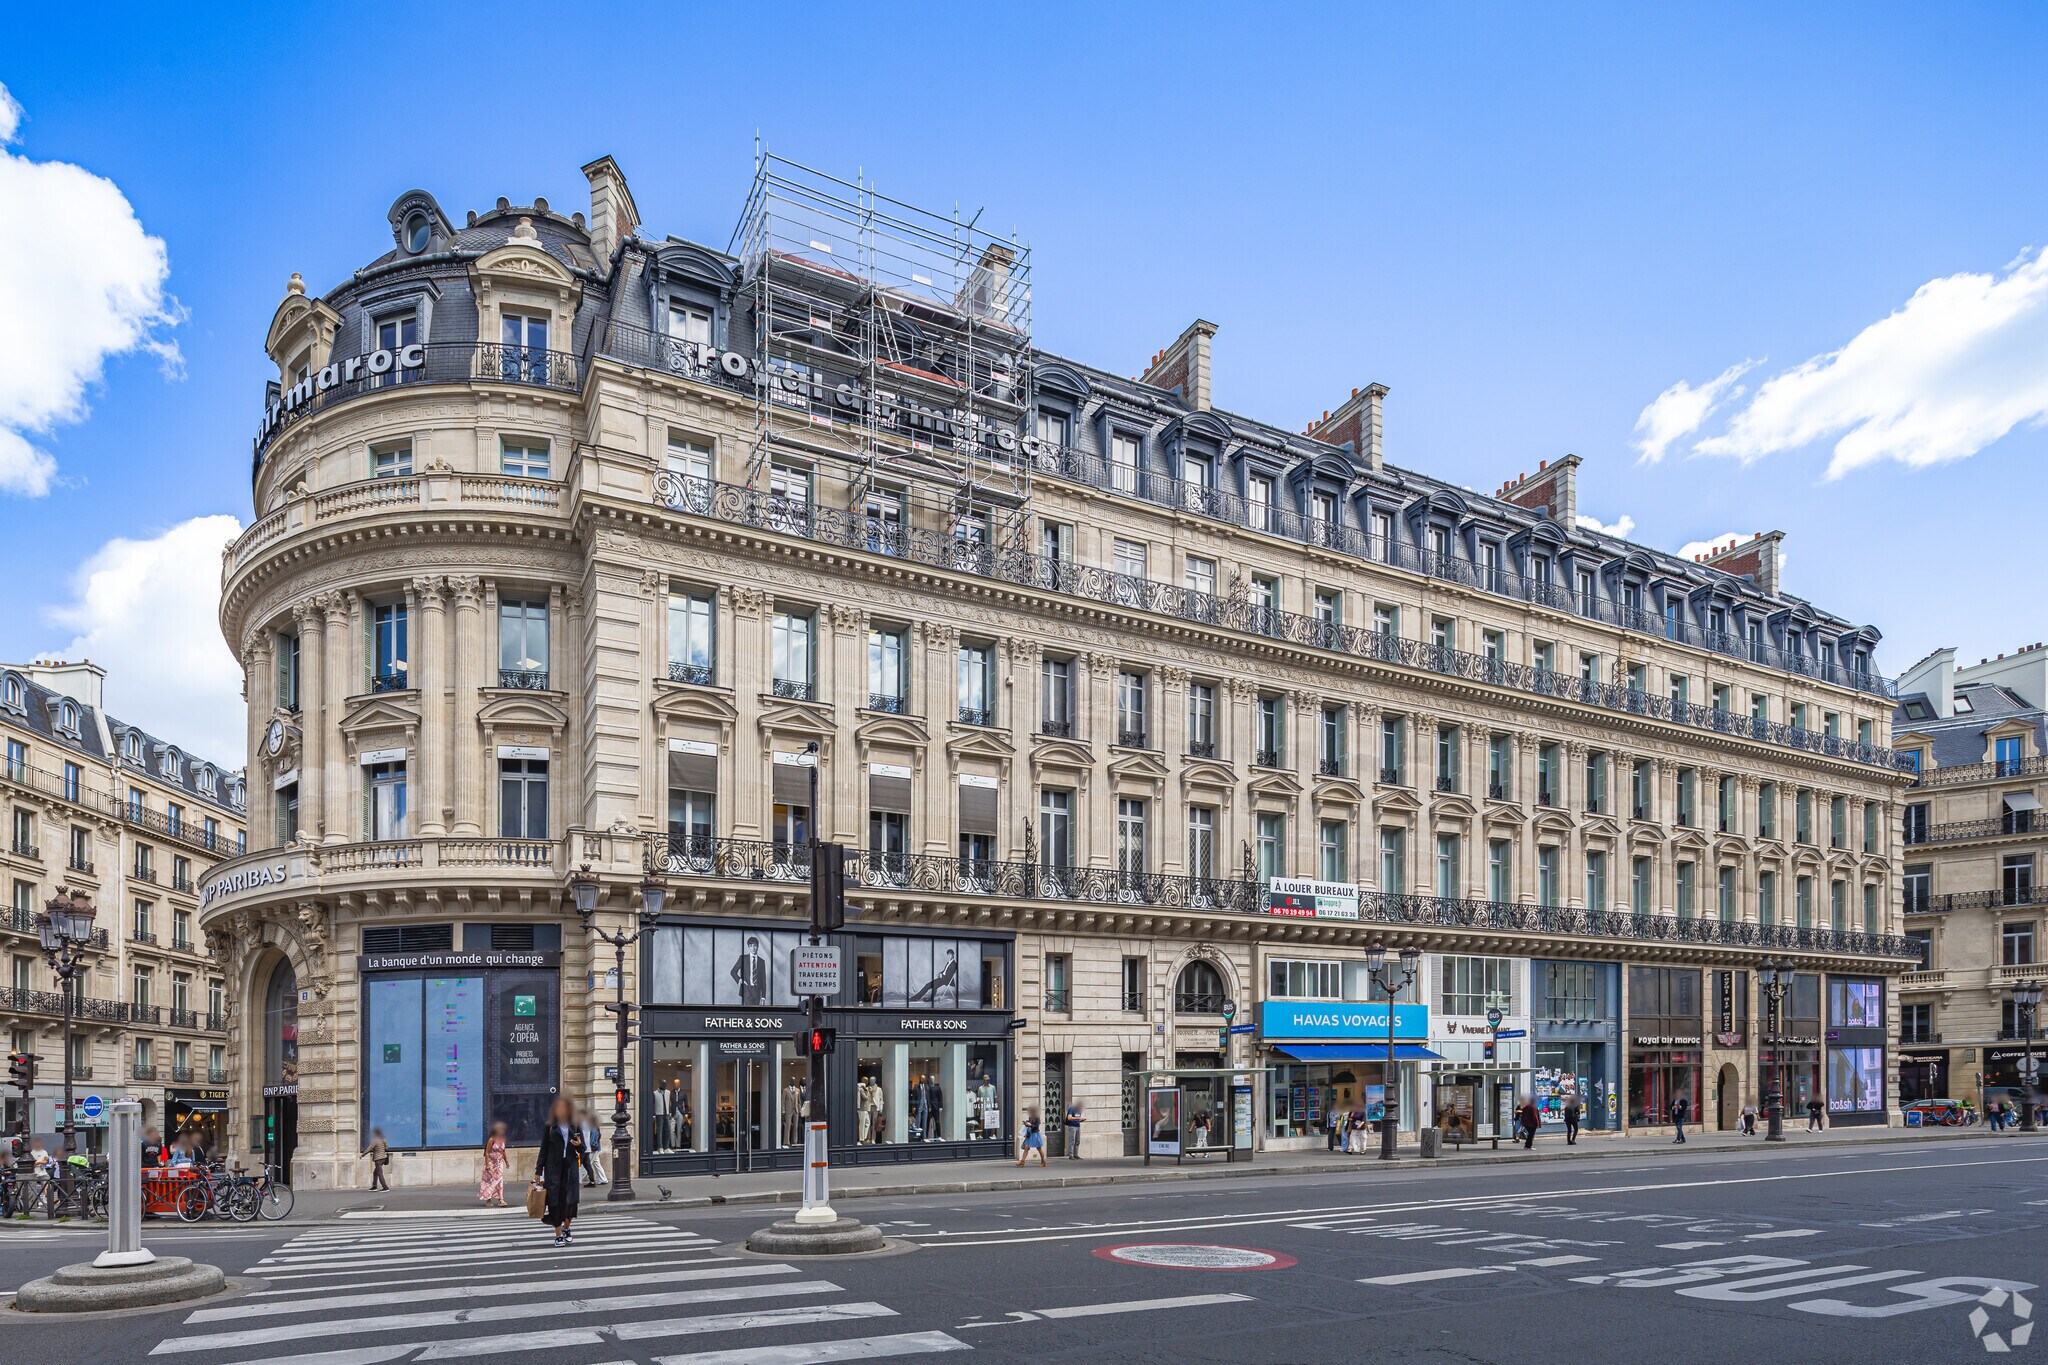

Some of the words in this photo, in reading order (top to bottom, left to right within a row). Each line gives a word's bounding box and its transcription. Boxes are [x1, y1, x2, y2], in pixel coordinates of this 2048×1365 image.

[286, 343, 426, 413] maroc
[697, 341, 823, 398] royal
[910, 403, 1042, 457] maroc
[218, 864, 287, 898] PARIBAS
[1284, 883, 1312, 894] LOUER
[1314, 886, 1354, 897] BUREAUX
[368, 958, 379, 968] La
[382, 956, 418, 968] banque
[420, 954, 442, 966] d'un
[445, 954, 482, 964] monde
[486, 954, 502, 966] qui
[506, 953, 544, 966] change
[705, 1018, 744, 1028] FATHER
[746, 1018, 752, 1028] &
[754, 1018, 782, 1028] SONS
[901, 1020, 934, 1029] FATHER
[936, 1020, 942, 1029] &
[944, 1020, 967, 1030] SONS
[1293, 1014, 1340, 1026] HAVAS
[510, 1032, 515, 1043] 2
[516, 1030, 539, 1043] OPÉRA
[264, 1086, 278, 1096] BNP
[1830, 1098, 1852, 1110] ba&sh
[1453, 1203, 1774, 1233] TRAFIC
[1286, 1218, 1626, 1254] LIMITÉ
[1568, 1254, 2039, 1318] BUS
